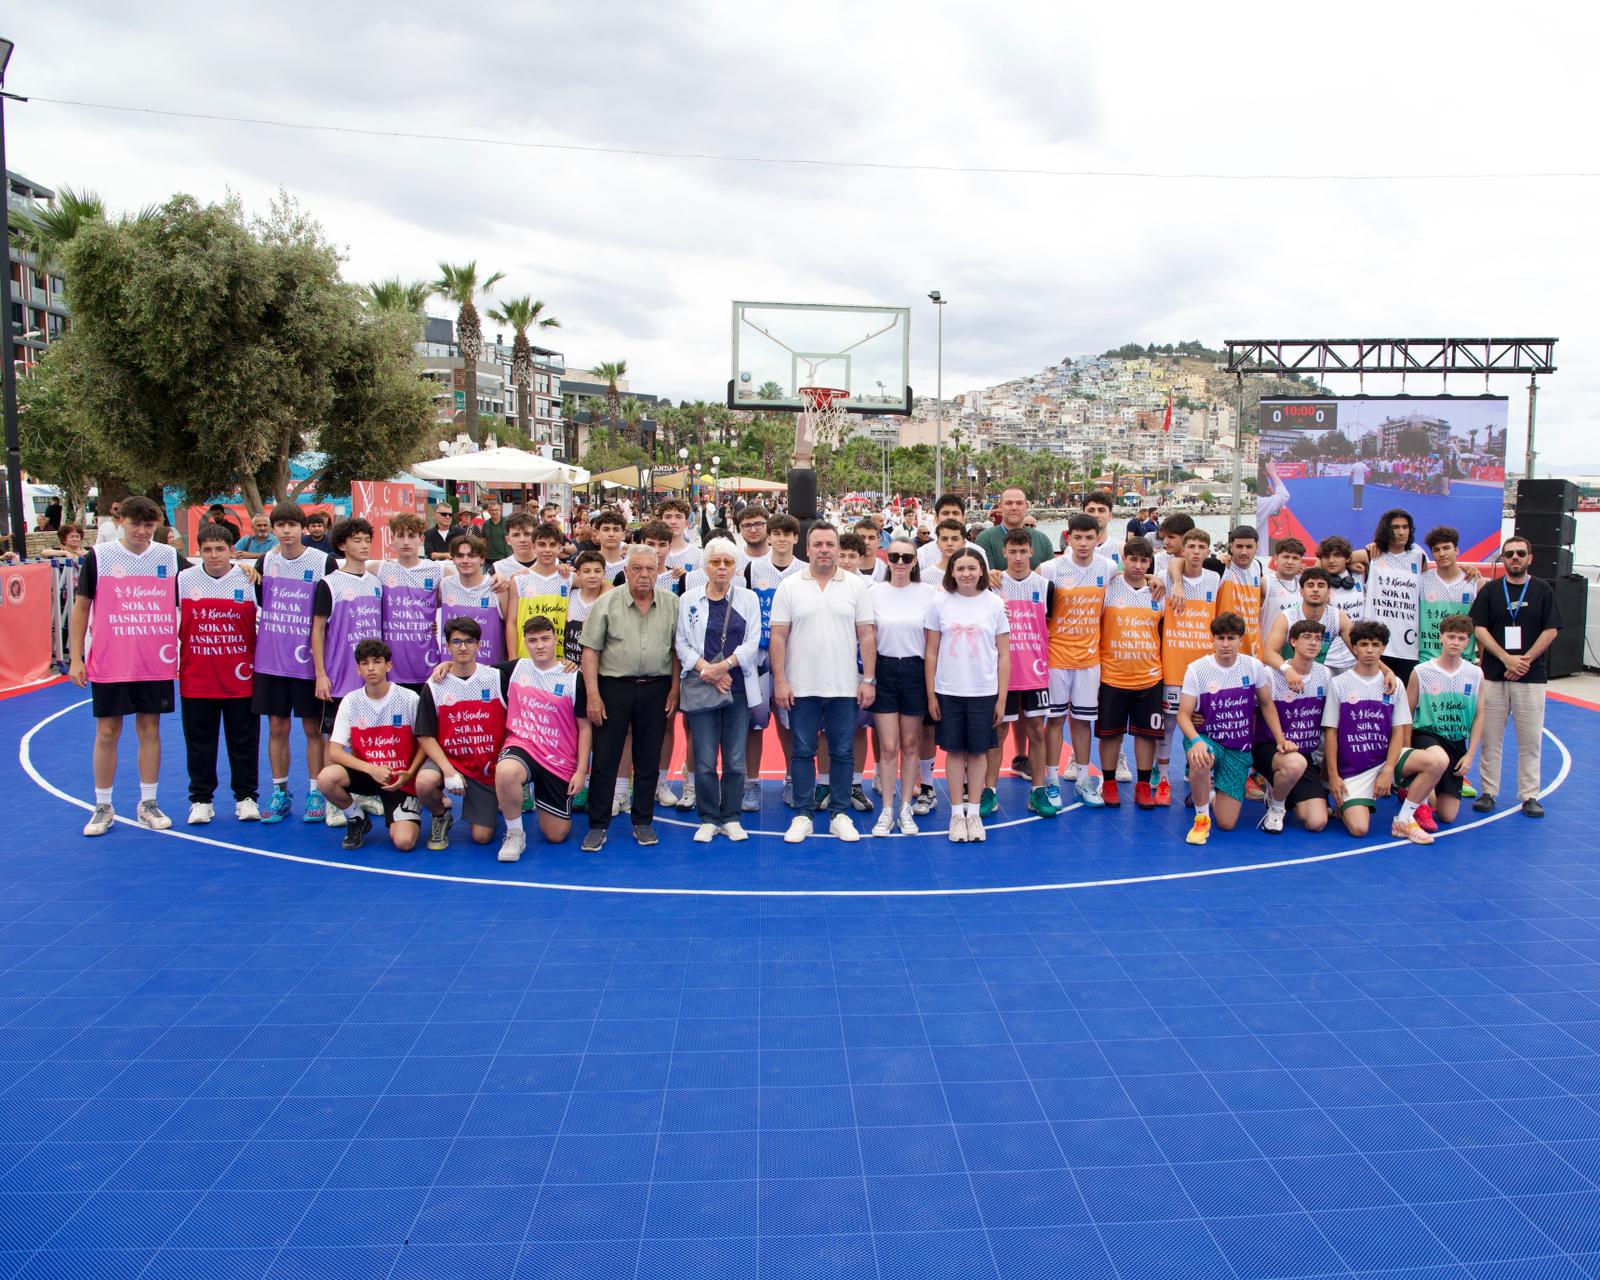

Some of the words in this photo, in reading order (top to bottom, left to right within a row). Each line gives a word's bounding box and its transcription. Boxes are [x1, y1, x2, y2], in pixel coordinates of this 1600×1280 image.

[1284, 405, 1316, 416] 10:00
[1273, 410, 1281, 422] 0
[1316, 410, 1324, 422] 0
[122, 602, 160, 611] SOKAK
[109, 614, 174, 624] BASKETBOL
[112, 626, 174, 636] TURNUVASI
[199, 624, 235, 632] SOKAK
[1037, 691, 1048, 707] 10
